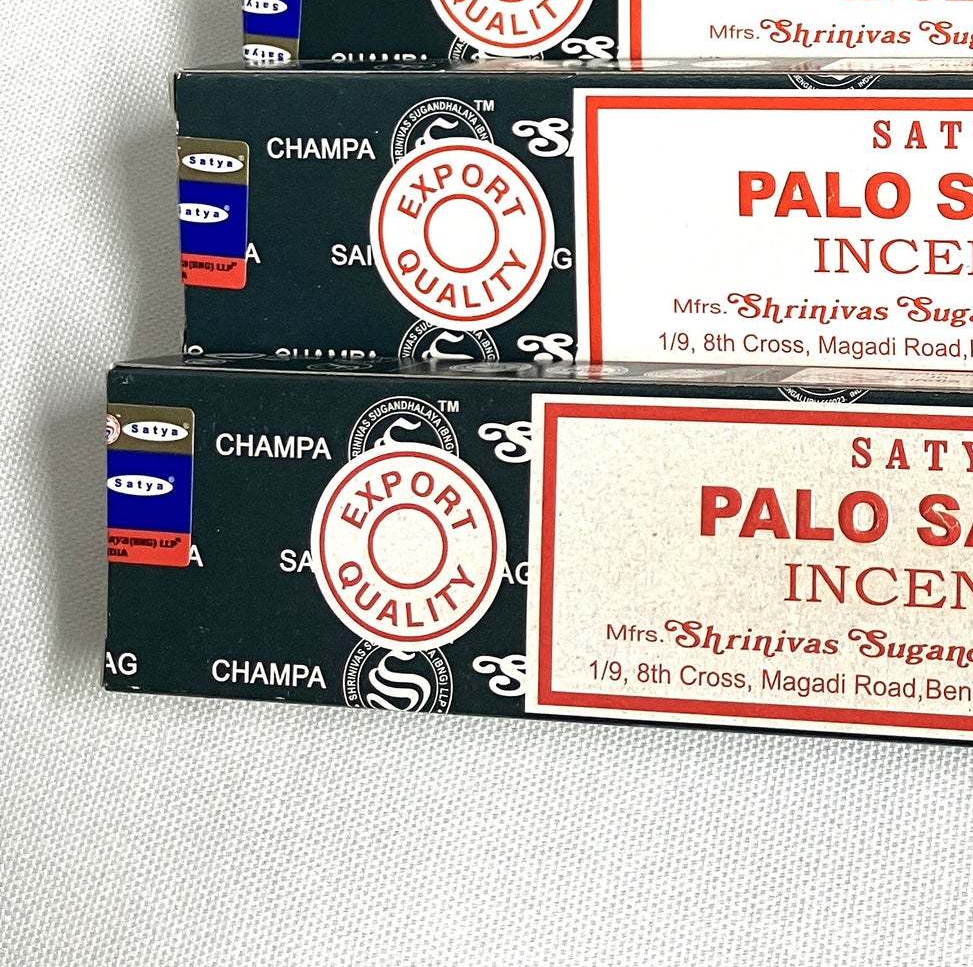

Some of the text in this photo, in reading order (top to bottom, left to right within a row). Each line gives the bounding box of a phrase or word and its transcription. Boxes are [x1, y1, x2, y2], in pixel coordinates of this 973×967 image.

[710, 25, 759, 39] Mfrs.
[757, 19, 911, 48] Shrinivas
[474, 100, 494, 111] TM
[267, 137, 375, 159] CHAMPA
[398, 164, 525, 225] EXPORT
[738, 171, 911, 219] PALO
[398, 242, 526, 308] QUALITY
[674, 299, 727, 314] Mfrs.
[724, 293, 888, 324] Shrinivas
[659, 332, 694, 353] 1/9,
[704, 333, 734, 351] 8th
[743, 334, 809, 356] Cross,
[819, 336, 895, 359] Magadi
[438, 400, 459, 412] TM
[216, 433, 331, 459] CHAMPA
[342, 471, 476, 535] EXPORT
[700, 486, 888, 545] PALO
[339, 555, 474, 627] QUALITY
[607, 624, 663, 642] Mfrs.
[660, 620, 839, 658] Shrinivas
[212, 660, 326, 688] CHAMPA
[590, 660, 627, 685] 1/9,
[637, 663, 670, 684] 8th
[680, 665, 751, 692] Cross,
[762, 669, 845, 697] Magadi
